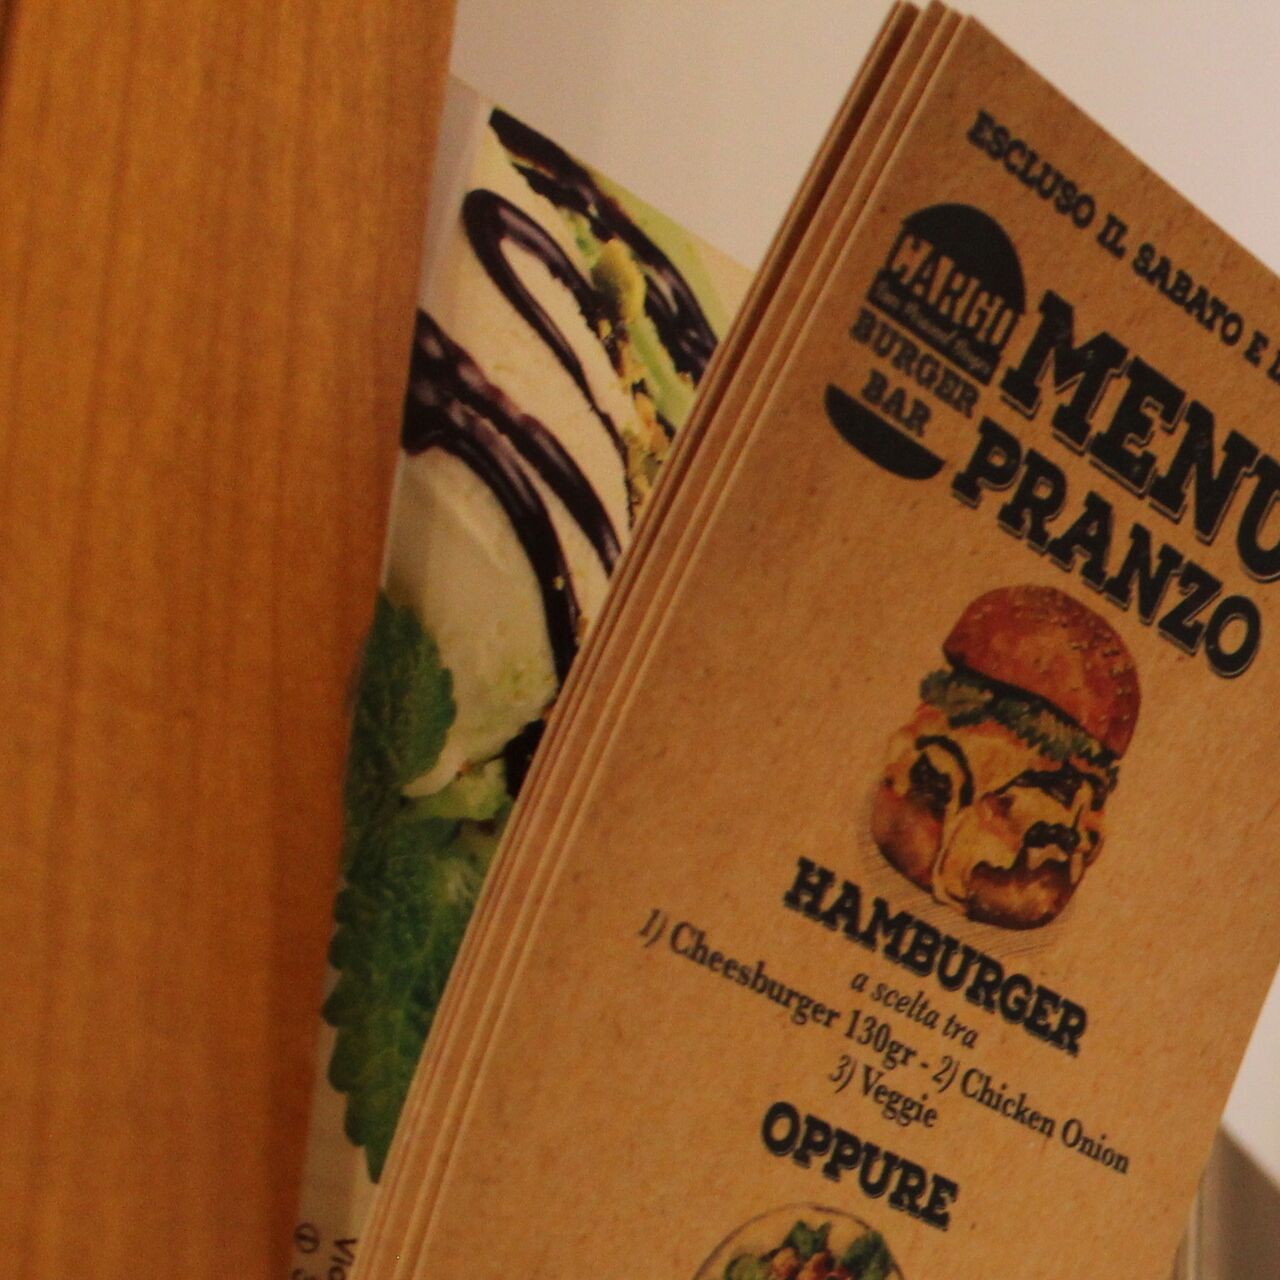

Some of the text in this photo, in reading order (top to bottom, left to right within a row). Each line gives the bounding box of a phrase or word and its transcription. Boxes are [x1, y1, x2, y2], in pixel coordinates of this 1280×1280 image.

[967, 109, 1095, 231] ESCLUSO
[1096, 213, 1127, 259] IL
[1132, 241, 1243, 347] SABATO
[1243, 326, 1268, 365] E
[849, 307, 979, 418] BURGER
[861, 370, 932, 437] BAR
[951, 416, 1262, 678] PRANZO
[782, 856, 1088, 1058] HAMBURGER
[850, 969, 980, 1050] a scelta tra
[637, 908, 669, 949] 1)
[669, 920, 841, 1030] Cheesburger
[843, 1008, 919, 1072] 130gr
[932, 1054, 961, 1093] 2)
[960, 1067, 1056, 1140] Chicken
[1061, 1117, 1131, 1176] Onion
[828, 1054, 940, 1131] 3) Veggie
[761, 1101, 960, 1231] OPPURE
